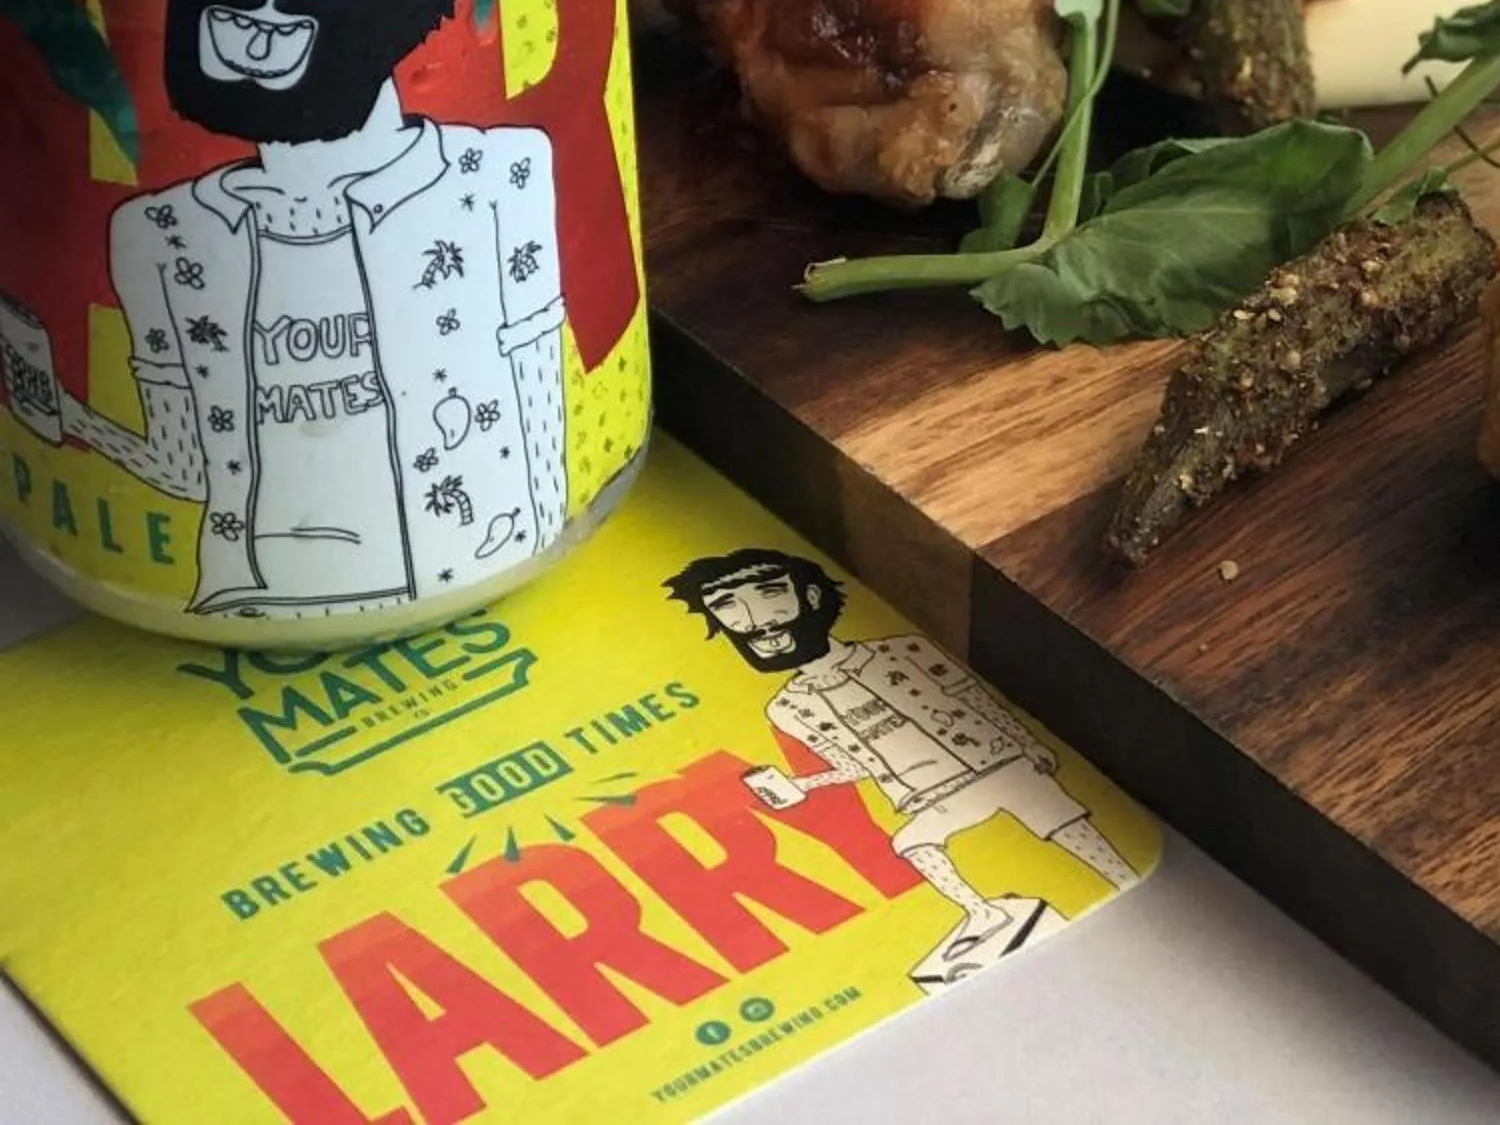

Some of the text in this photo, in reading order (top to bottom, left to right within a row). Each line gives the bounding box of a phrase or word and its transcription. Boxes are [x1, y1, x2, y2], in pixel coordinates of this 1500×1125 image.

[255, 371, 386, 425] MATES
[12, 453, 175, 565] PALE
[236, 608, 512, 764] MATES
[220, 681, 701, 920] BREWING GOOD TIMES
[186, 720, 928, 1125] LARRY
